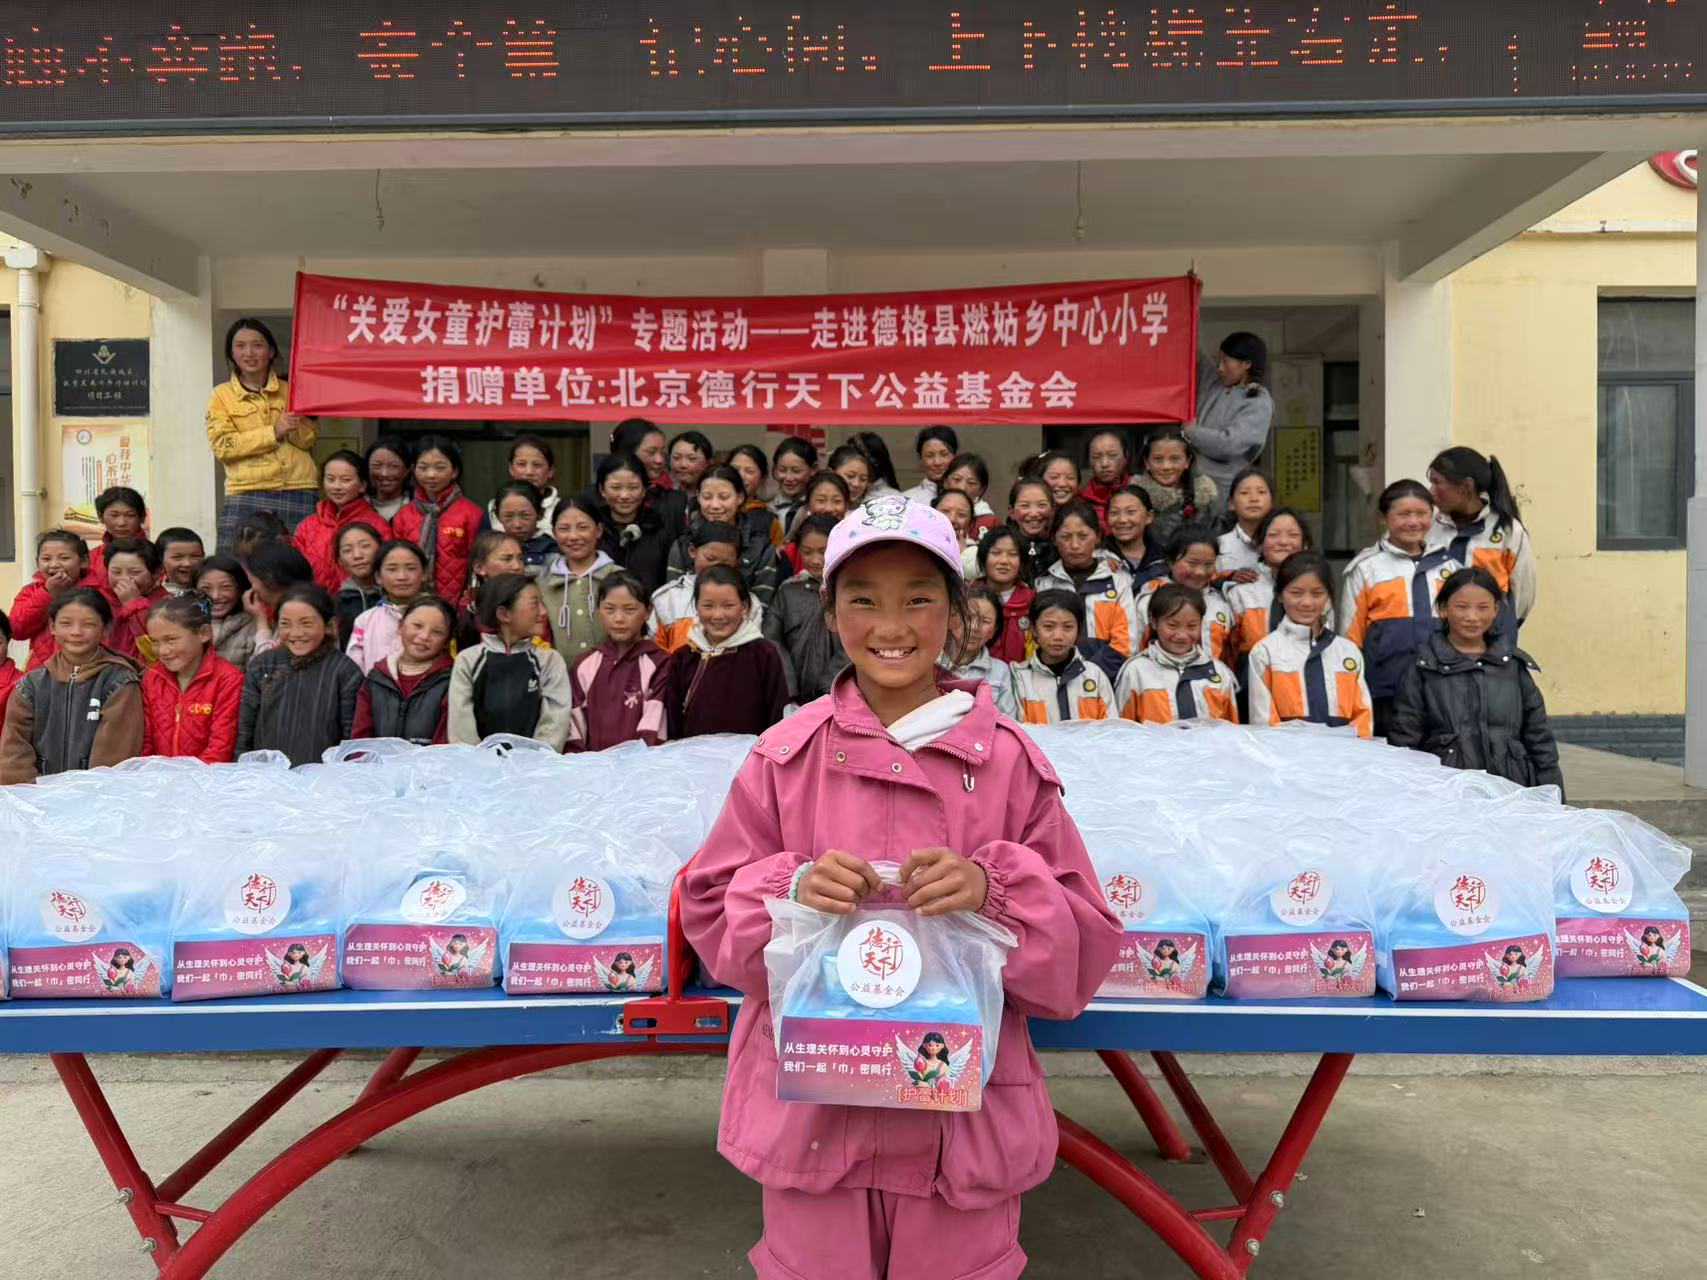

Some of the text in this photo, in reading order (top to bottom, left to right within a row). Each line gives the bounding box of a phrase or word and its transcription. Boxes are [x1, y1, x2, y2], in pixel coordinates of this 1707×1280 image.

[784, 1042, 893, 1057] 从生理关怀到心灵守护
